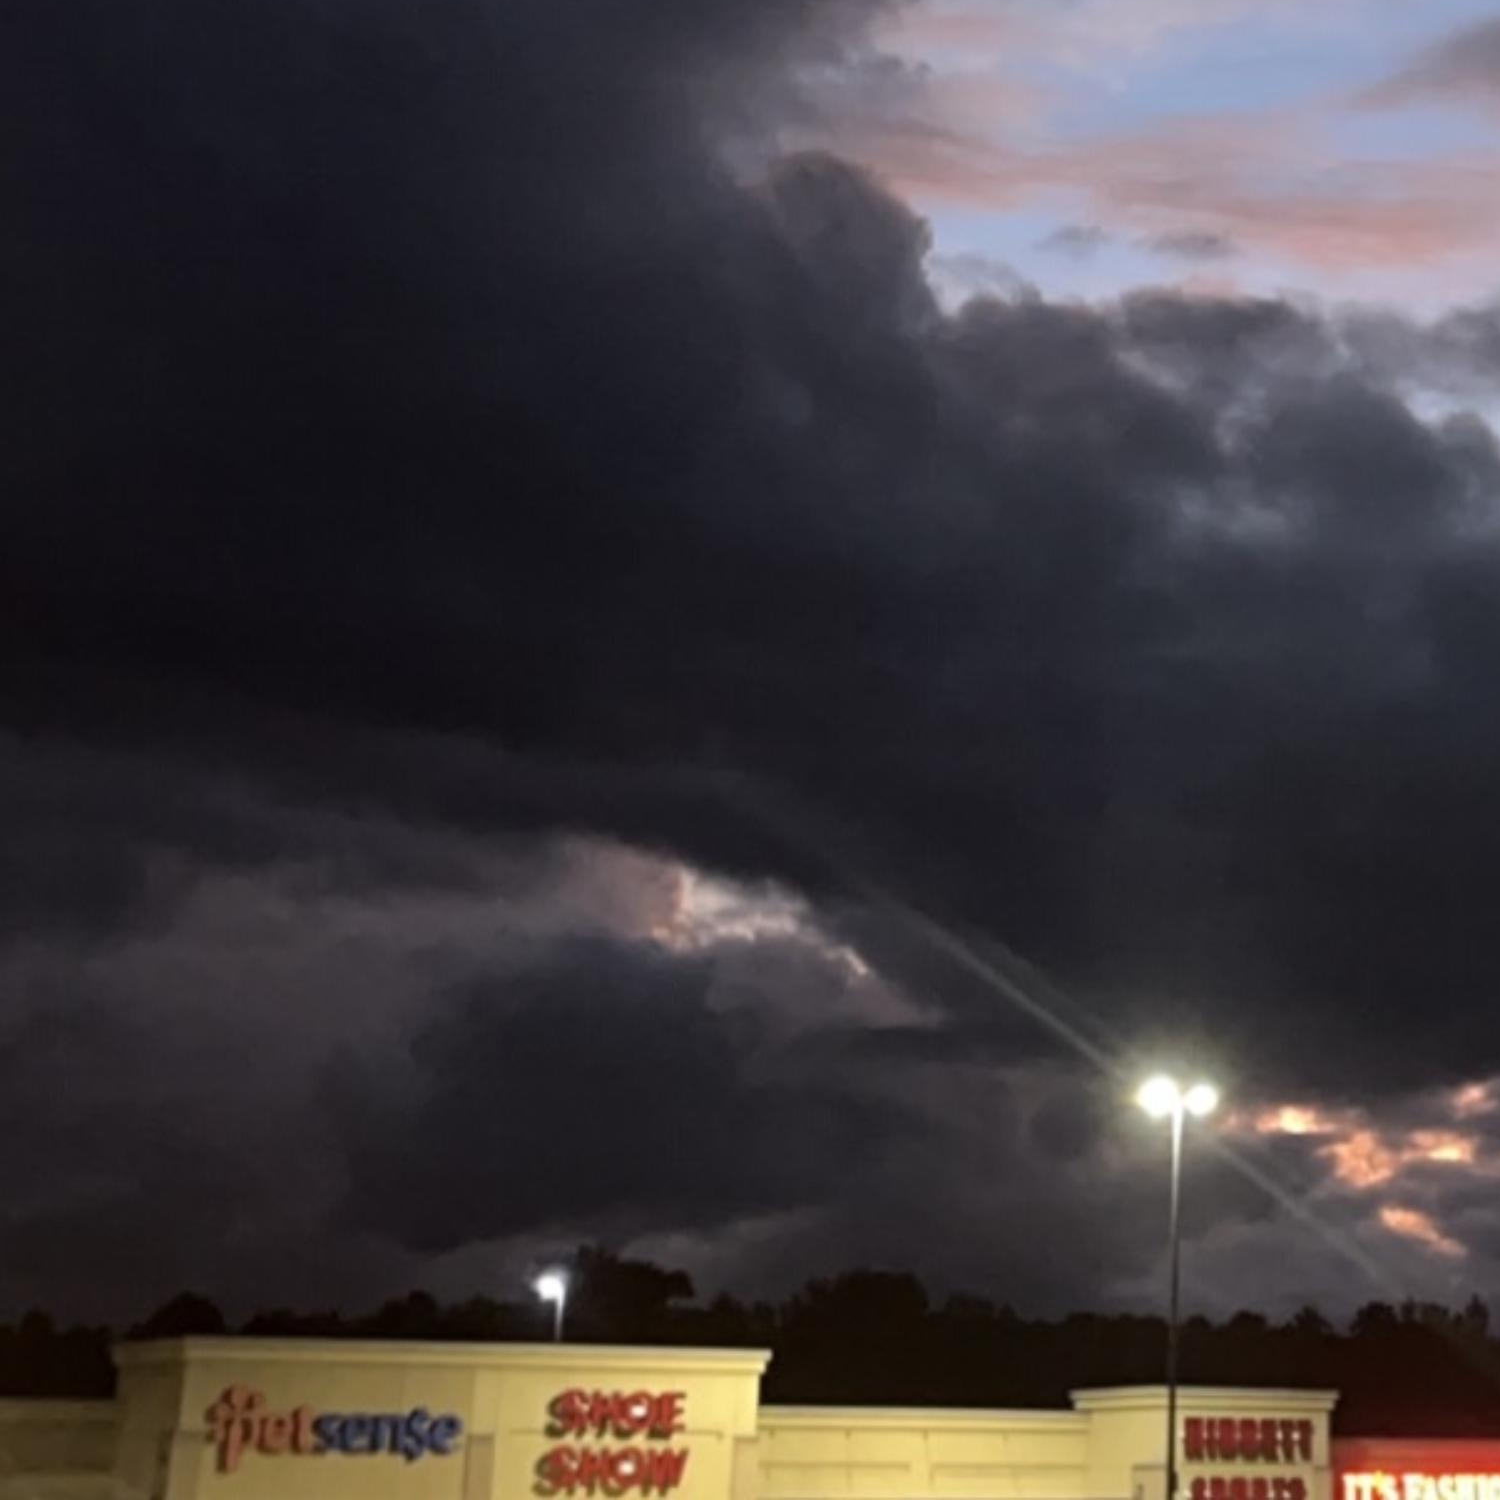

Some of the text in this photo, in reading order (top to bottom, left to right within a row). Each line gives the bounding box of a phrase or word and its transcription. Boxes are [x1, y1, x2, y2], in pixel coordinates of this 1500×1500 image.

[205, 1384, 462, 1473] petsense
[545, 1388, 687, 1439] SHOE
[532, 1446, 690, 1498] SHOW
